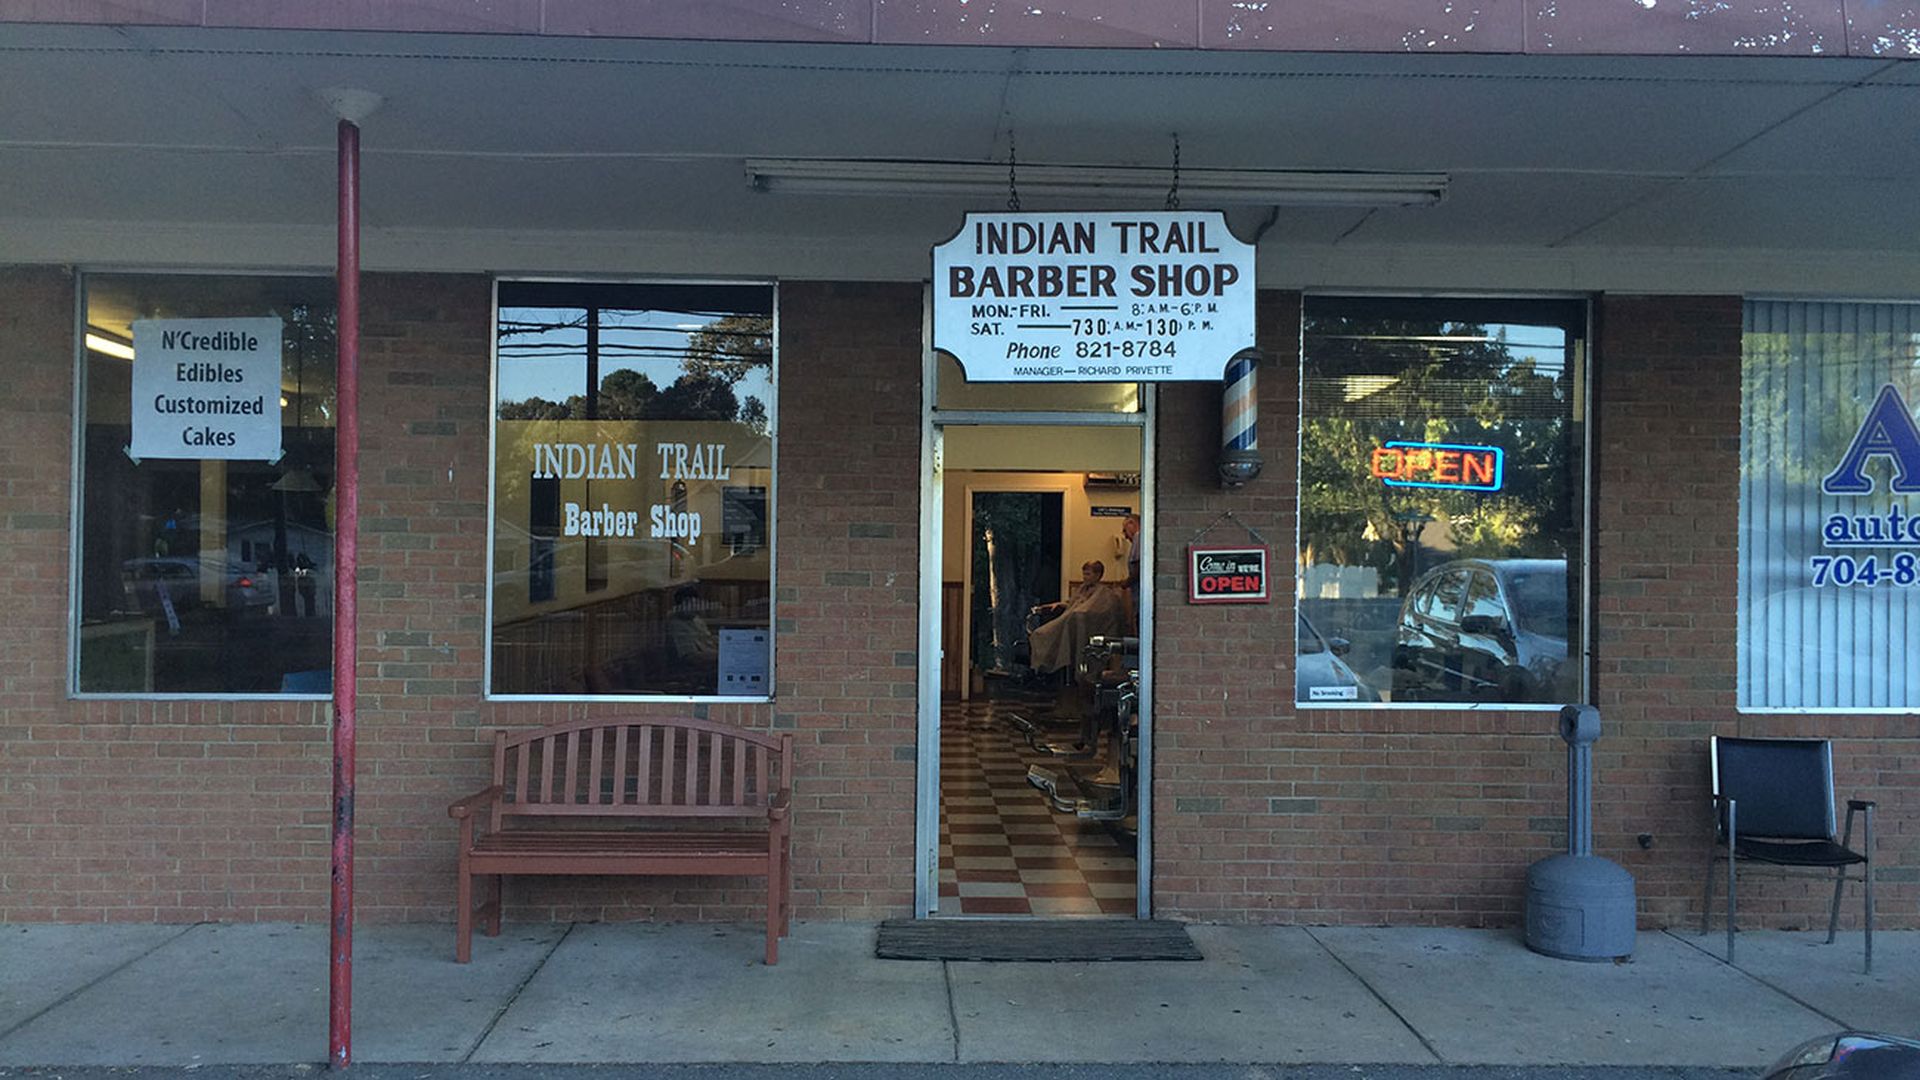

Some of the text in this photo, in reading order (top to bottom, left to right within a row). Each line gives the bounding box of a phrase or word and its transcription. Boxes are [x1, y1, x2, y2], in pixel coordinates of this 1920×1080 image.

[976, 221, 1220, 254] INDIAN TRAIL
[950, 264, 1239, 298] BARBER SHOP
[971, 322, 1005, 336] SAT.
[1006, 340, 1176, 359] Phone 821-8784
[176, 362, 243, 382] Edibles
[1125, 365, 1173, 375] PRIVETTE
[154, 394, 263, 415] Customized
[182, 427, 236, 446] Cakes
[532, 442, 730, 480] INDIAN TRAIL
[1371, 447, 1493, 482] OPEN
[564, 503, 637, 537] Barber
[650, 503, 702, 545] Shop
[1811, 553, 1920, 587] 704-8
[1201, 576, 1259, 592] OPEN
